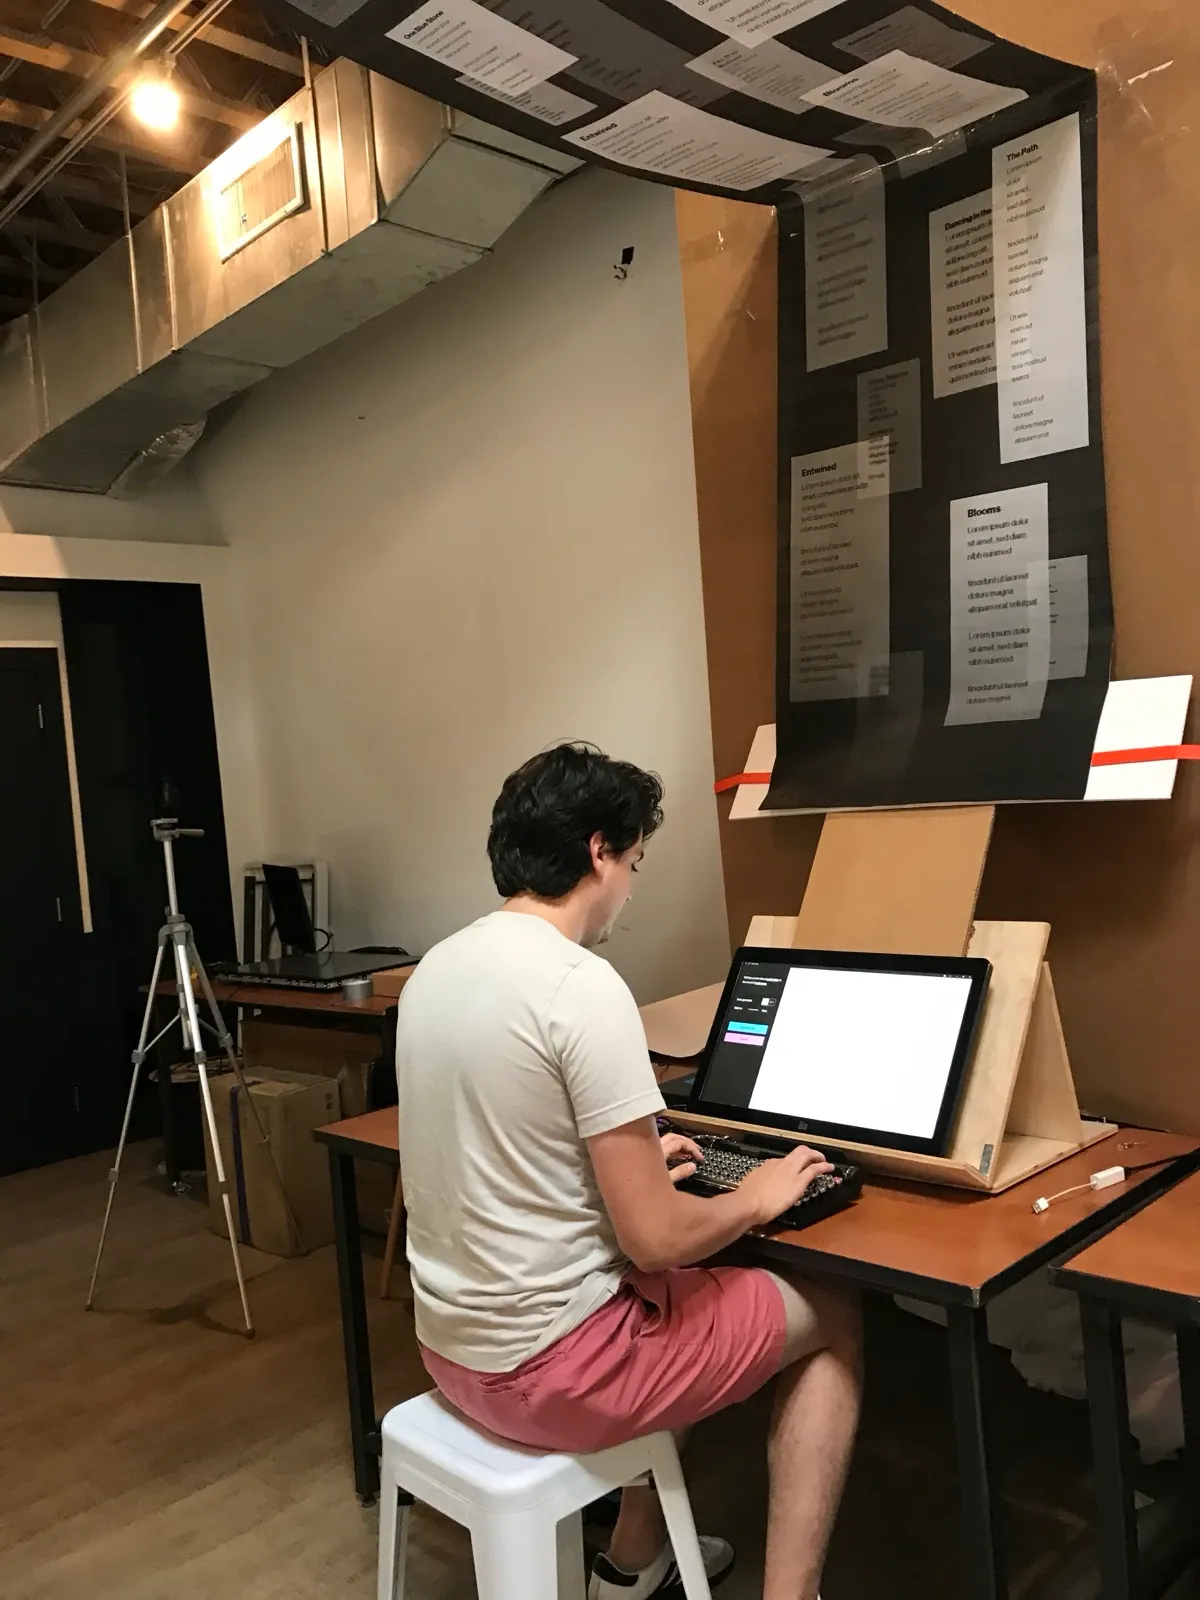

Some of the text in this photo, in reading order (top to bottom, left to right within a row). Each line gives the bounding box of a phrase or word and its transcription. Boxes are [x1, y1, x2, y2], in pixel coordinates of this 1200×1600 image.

[404, 10, 444, 40] One Blue Stone
[580, 122, 618, 141] Entwined
[1006, 144, 1038, 162] The Path
[1006, 178, 1021, 186] dolor
[1006, 202, 1018, 211] sed
[944, 208, 992, 230] Dancing in the
[1028, 256, 1048, 268] magna
[1014, 418, 1054, 432] dolore magna
[802, 462, 837, 476] Entwined
[968, 506, 1002, 518] Blooms
[967, 518, 1029, 534] Lorem ipsum dolor
[967, 540, 975, 548] sit
[996, 534, 1010, 542] sed
[1010, 532, 1026, 540] diam
[967, 552, 982, 560] nibh
[990, 588, 1014, 598] magna
[968, 632, 990, 640] Lorem
